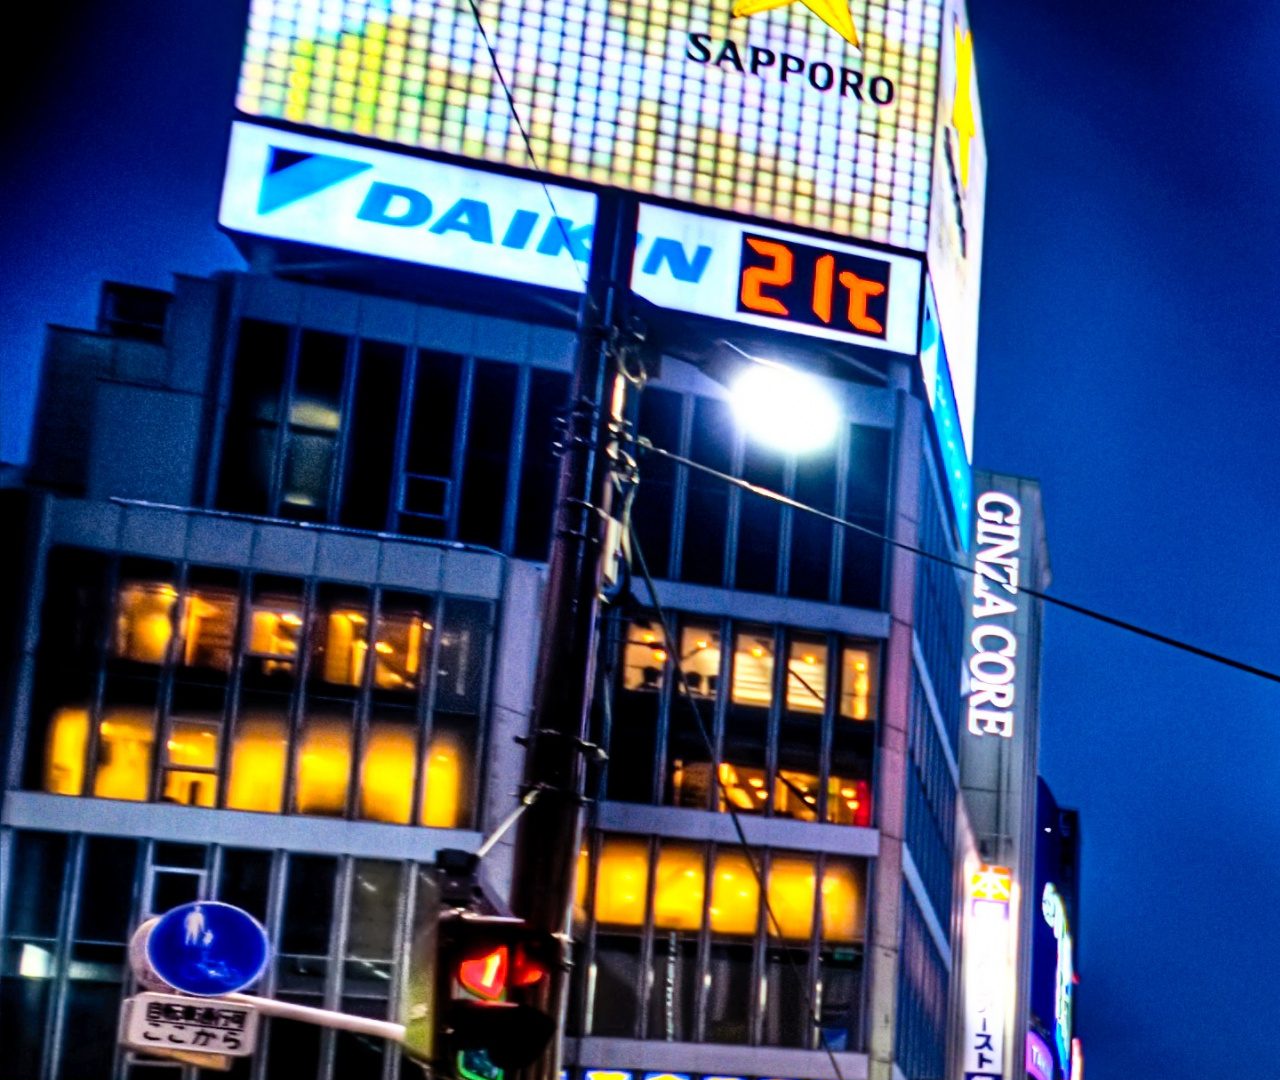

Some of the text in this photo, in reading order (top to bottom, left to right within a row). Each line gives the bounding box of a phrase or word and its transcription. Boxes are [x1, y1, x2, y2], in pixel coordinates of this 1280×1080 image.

[688, 33, 896, 106] SAPPORO
[357, 180, 713, 283] DAIKN
[967, 491, 1022, 740] GINZA CORE
[142, 1021, 243, 1050] ここから
